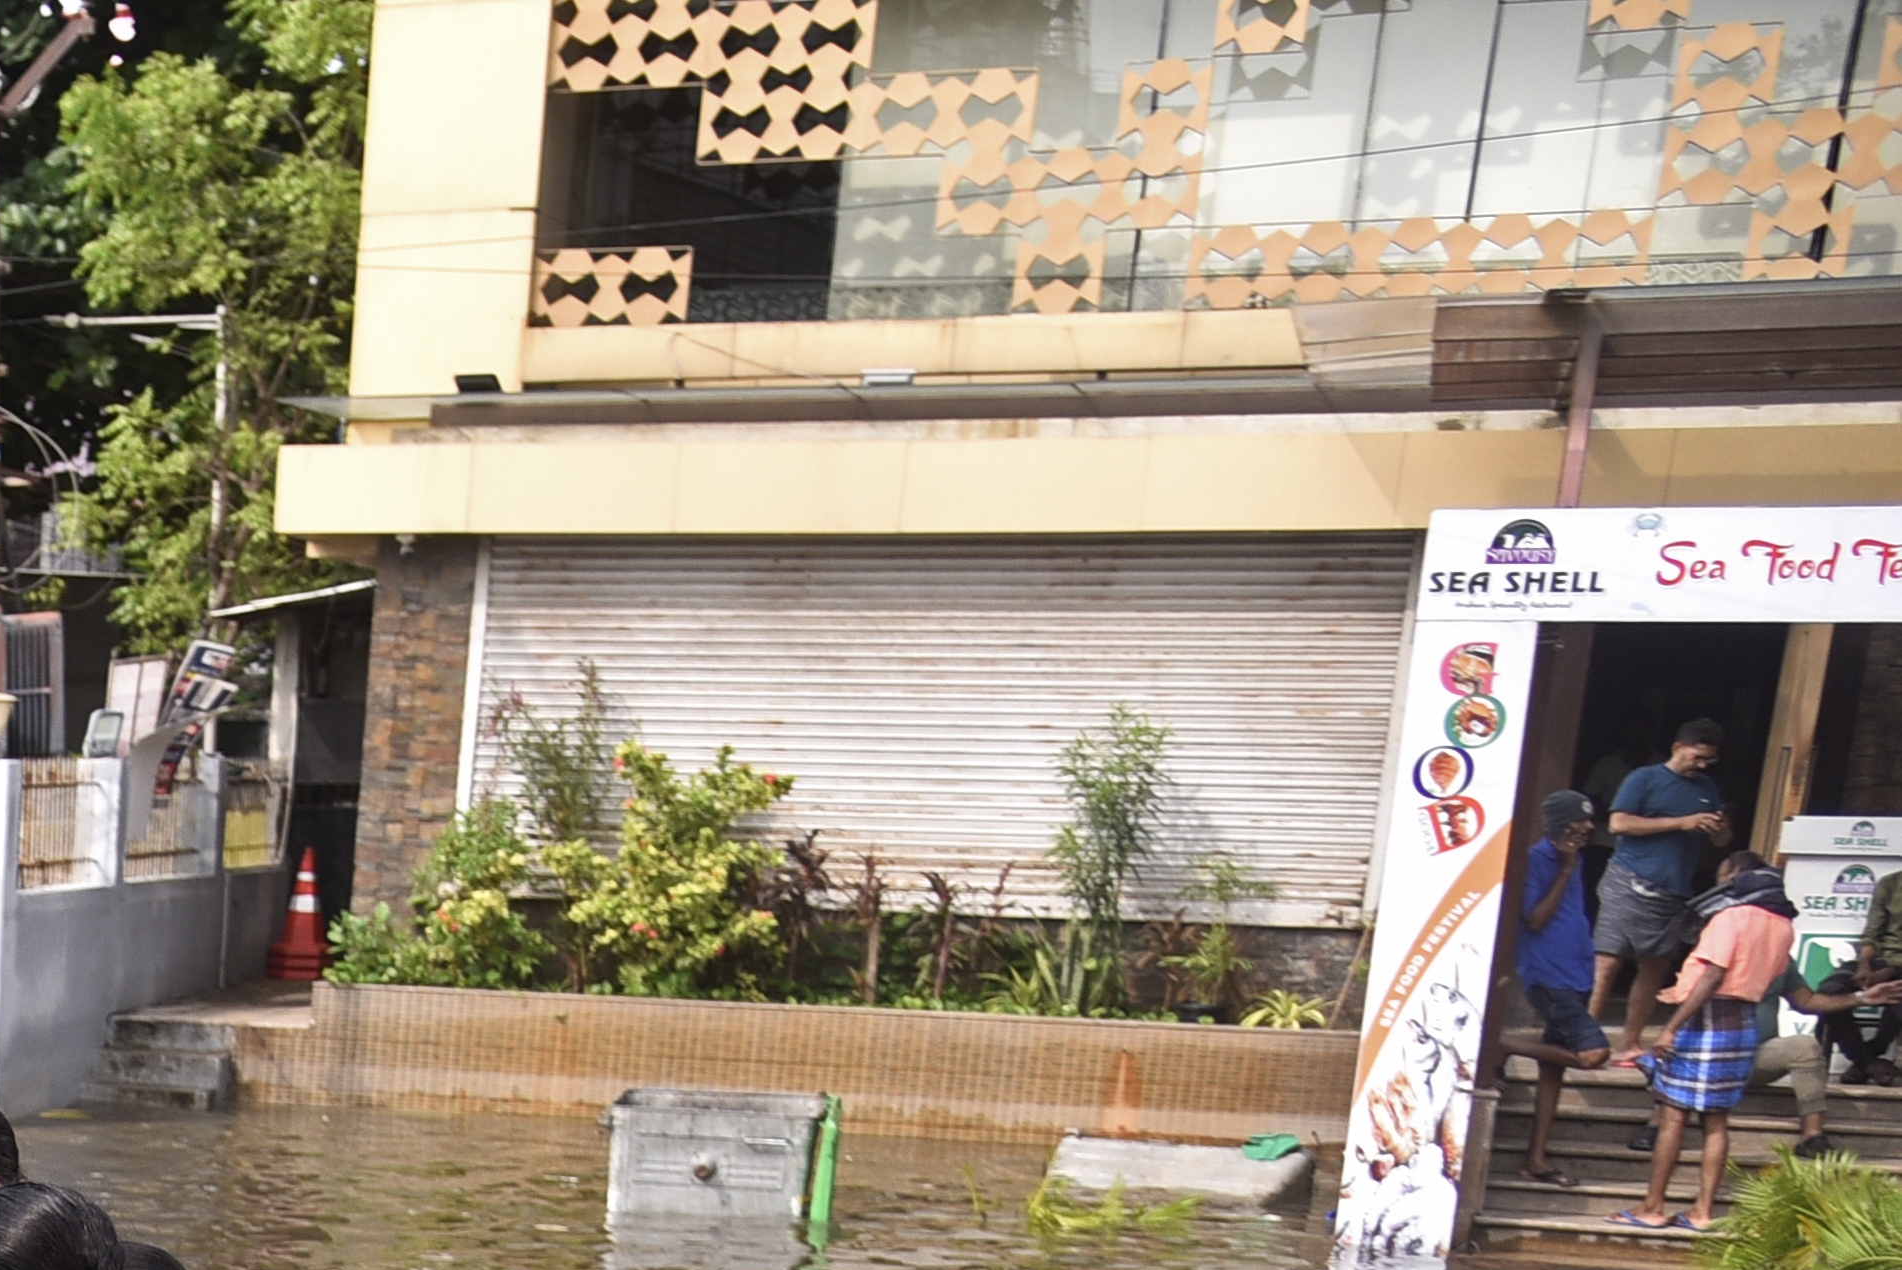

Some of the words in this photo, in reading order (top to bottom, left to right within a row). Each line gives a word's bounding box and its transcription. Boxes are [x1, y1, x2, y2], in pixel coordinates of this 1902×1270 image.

[1429, 571, 1491, 595] SEA
[1503, 571, 1605, 595] SHELL
[1656, 540, 1726, 586] Sea
[1741, 539, 1842, 586] Food
[1394, 953, 1427, 996] FOOD
[1421, 890, 1482, 954] FESTIVAL
